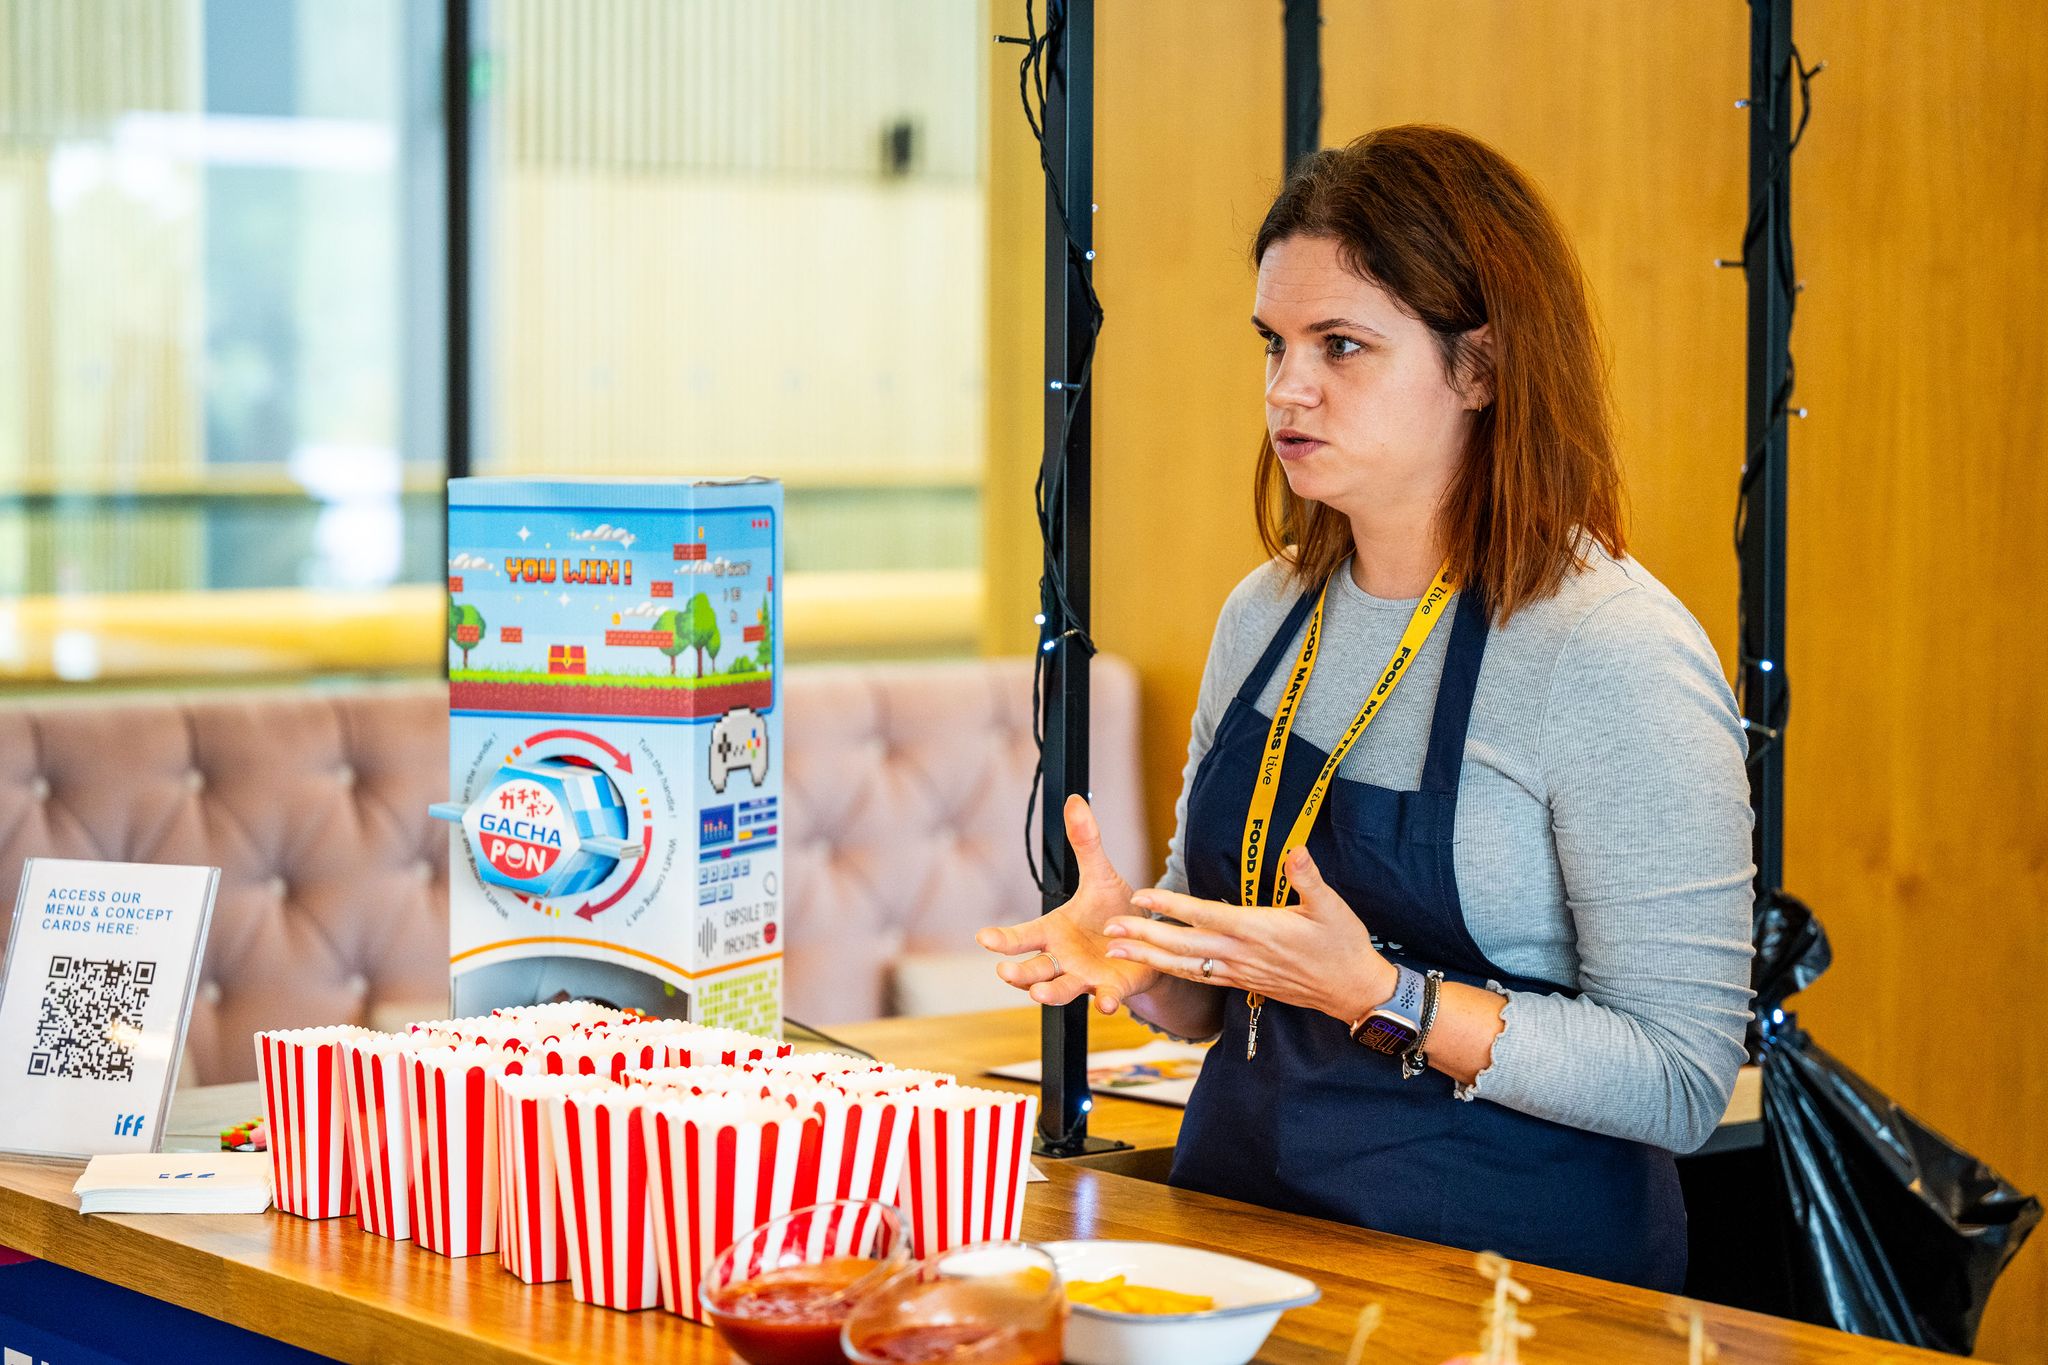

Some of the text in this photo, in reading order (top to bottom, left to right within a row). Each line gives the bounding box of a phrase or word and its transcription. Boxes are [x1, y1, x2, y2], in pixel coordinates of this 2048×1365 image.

[505, 557, 557, 583] YOU
[1421, 587, 1448, 615] live
[1263, 610, 1319, 785] FOOD MATTERS live
[1304, 646, 1411, 816] FOOD MATTERS live
[480, 814, 561, 847] GACHA
[490, 839, 546, 874] PON
[1247, 819, 1263, 873] FOOD
[48, 888, 141, 904] ACCESS OUR
[42, 918, 139, 935] CARDS HERE:
[45, 904, 174, 921] MENU & CONCEPT
[114, 1114, 145, 1137] iff
